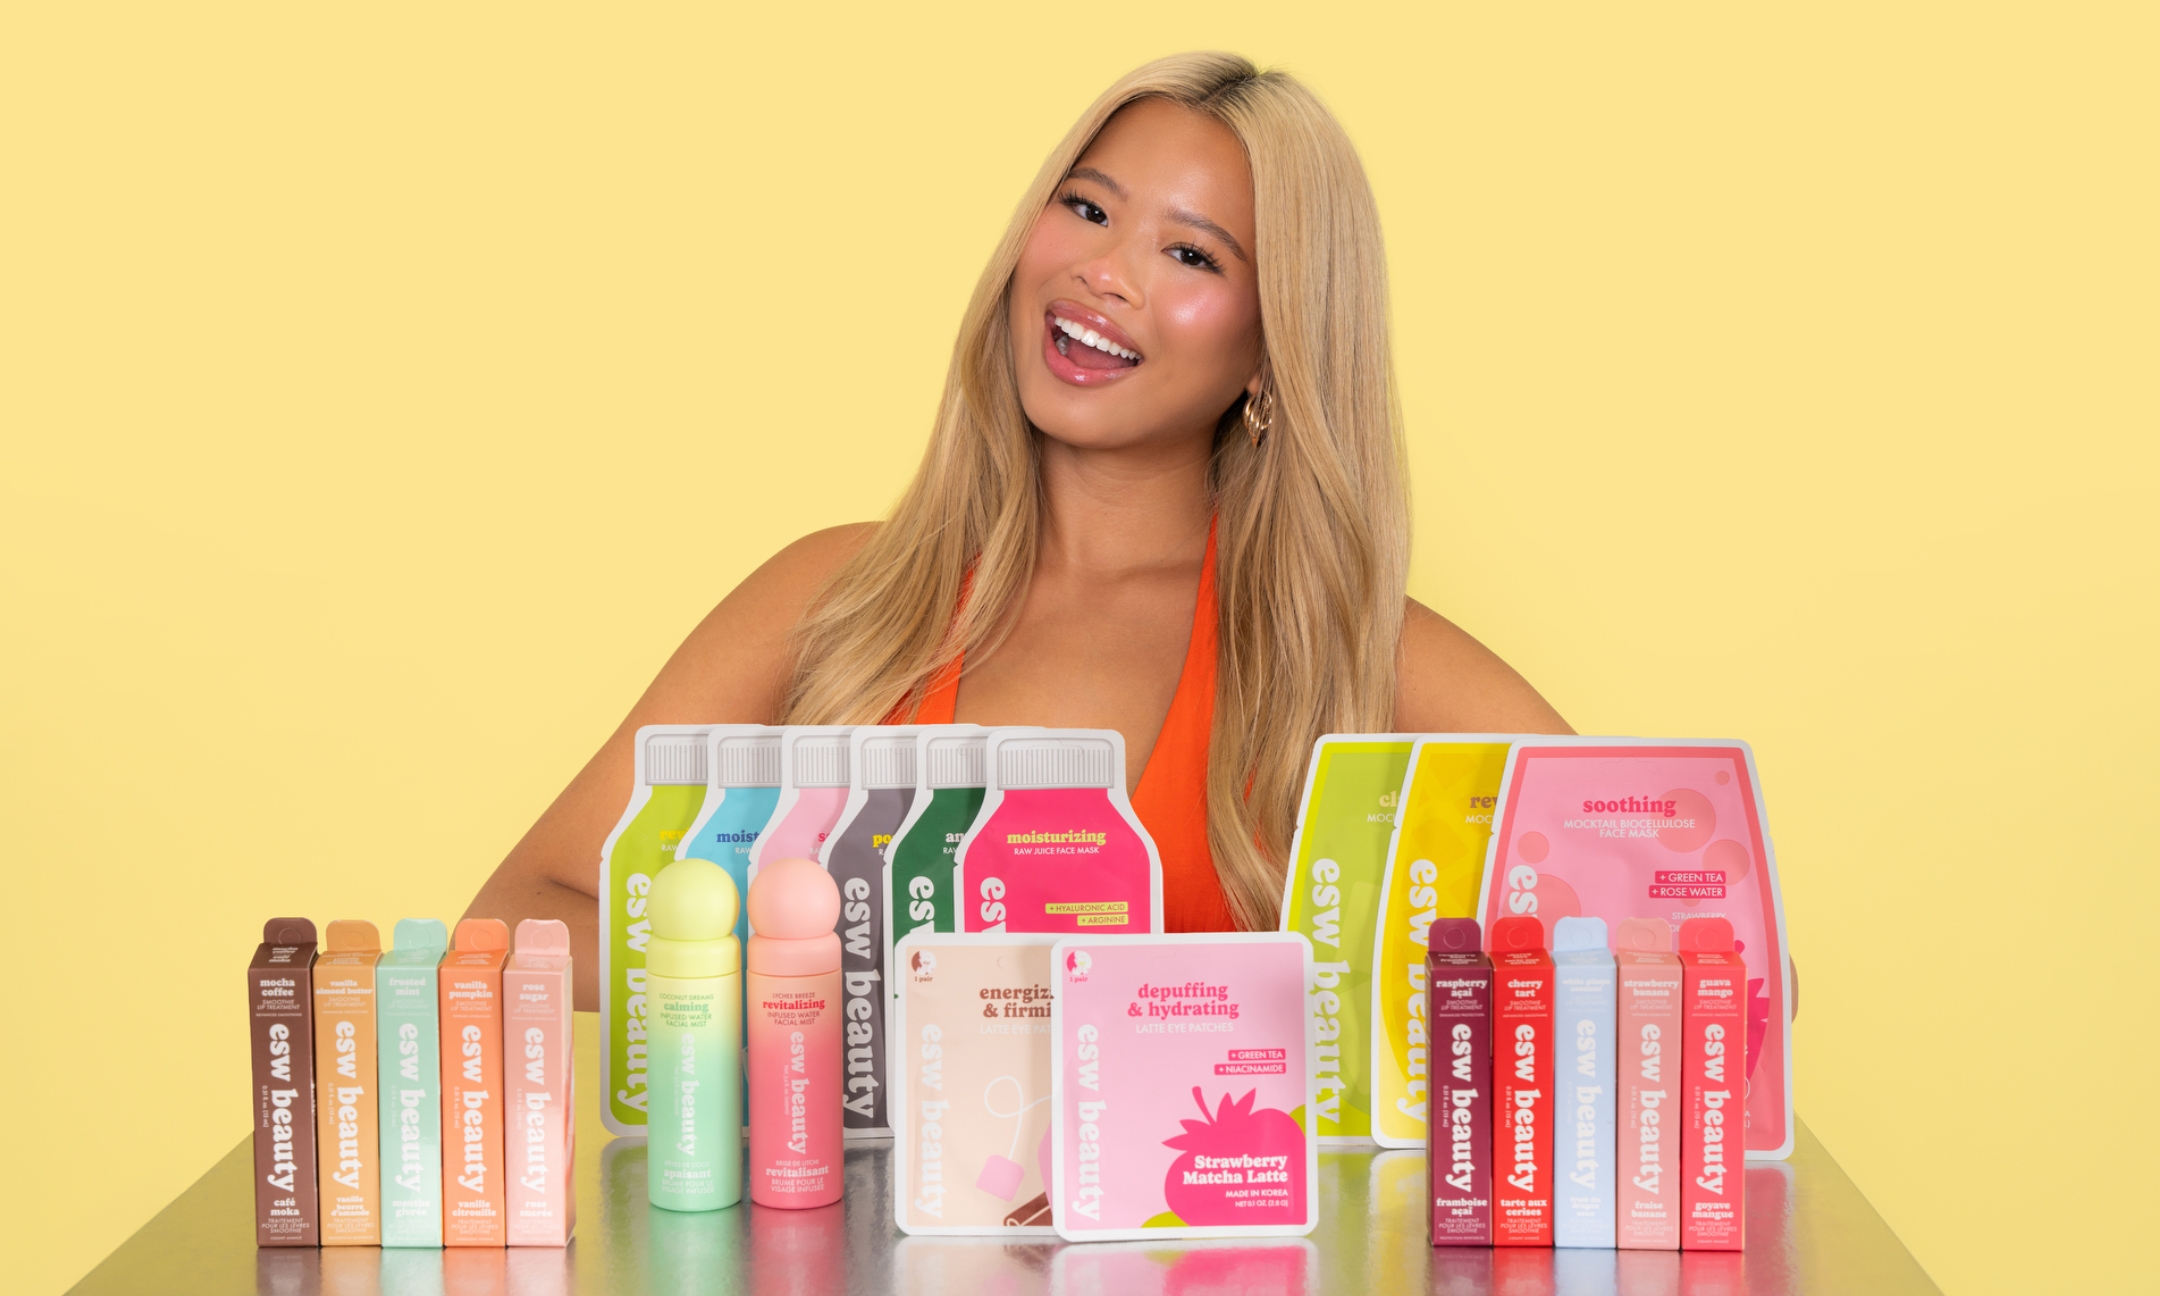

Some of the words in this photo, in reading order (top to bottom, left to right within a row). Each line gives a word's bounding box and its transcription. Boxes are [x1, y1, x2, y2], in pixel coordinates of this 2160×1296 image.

[1583, 796, 1676, 817] soothing
[1564, 819, 1616, 828] MOCKTAIL
[1620, 819, 1695, 828] BIOCELLULOSE
[1007, 829, 1106, 846] moisturizing
[1600, 829, 1626, 838] FACE
[1628, 830, 1659, 838] MASK
[1668, 873, 1703, 882] GREEN
[1705, 873, 1723, 882] TEA
[1660, 887, 1687, 896] ROSE
[1689, 887, 1722, 896] WATER
[1312, 858, 1340, 948] esw
[844, 877, 871, 960] esw
[260, 978, 295, 986] mocha
[389, 977, 426, 986] frosted
[454, 981, 487, 989] vanilla
[1436, 978, 1488, 989] raspberry
[1507, 979, 1543, 990] cherry
[1624, 979, 1679, 990] strawberry
[1700, 979, 1731, 988] guava
[261, 987, 294, 996] coffee
[396, 987, 420, 996] mint
[449, 990, 493, 999] pumpkin
[519, 993, 549, 1002] sugar
[1138, 982, 1228, 1002] depuffing
[1515, 989, 1535, 997] tart
[1633, 988, 1670, 996] banana
[1698, 989, 1733, 998] mango
[664, 1002, 709, 1013] calming
[763, 999, 825, 1011] revitalizing
[983, 1003, 998, 1018] &
[1127, 1002, 1143, 1017] &
[1148, 1000, 1239, 1020] hydrating
[980, 1025, 1010, 1034] LATTE
[1012, 1025, 1031, 1034] EYE
[1136, 1024, 1165, 1034] LATTE
[1168, 1024, 1186, 1033] EYE
[1189, 1023, 1234, 1033] PATCHES
[843, 969, 881, 1119] beauty
[1310, 960, 1350, 1123] beauty
[1576, 1019, 1596, 1078] esw
[269, 1023, 290, 1081] esw
[335, 1021, 356, 1079] esw
[399, 1023, 419, 1081] esw
[462, 1025, 481, 1083] esw
[525, 1027, 544, 1085] esw
[681, 1032, 695, 1075] esw
[790, 1032, 805, 1073] esw
[921, 1023, 943, 1091] esw
[1077, 1023, 1100, 1092] esw
[1452, 1024, 1472, 1082] esw
[1515, 1024, 1535, 1082] esw
[1641, 1023, 1661, 1083] esw
[1704, 1023, 1725, 1083] esw
[1226, 1065, 1283, 1074] NIACINAMIDE
[677, 1079, 700, 1156] beauty
[787, 1078, 810, 1154] beauty
[268, 1088, 298, 1192] beauty
[333, 1086, 364, 1189] beauty
[395, 1089, 426, 1192] beauty
[458, 1090, 489, 1193] beauty
[520, 1092, 551, 1193] beauty
[1446, 1089, 1478, 1192] beauty
[1508, 1089, 1541, 1192] beauty
[1569, 1085, 1603, 1190] beauty
[1632, 1090, 1666, 1194] beauty
[1696, 1090, 1731, 1195] beauty
[915, 1100, 950, 1219] beauty
[1072, 1100, 1107, 1222] beauty
[1194, 1154, 1288, 1170] Strawberry
[664, 1168, 711, 1179] apaisant
[765, 1165, 829, 1177] revitalisant
[1183, 1170, 1243, 1185] Matcha
[1247, 1170, 1288, 1183] Latte
[274, 1197, 295, 1207] café
[392, 1198, 431, 1207] menthe
[458, 1200, 490, 1208] vanille
[1437, 1198, 1487, 1207] framboise
[1500, 1199, 1526, 1207] tarte
[1635, 1201, 1663, 1209] fraise
[1696, 1202, 1730, 1211] goyave
[270, 1208, 299, 1216] moka
[452, 1208, 496, 1216] citrouille
[1506, 1208, 1542, 1216] cerises
[1631, 1210, 1667, 1218] banane
[1692, 1211, 1734, 1220] mangue
